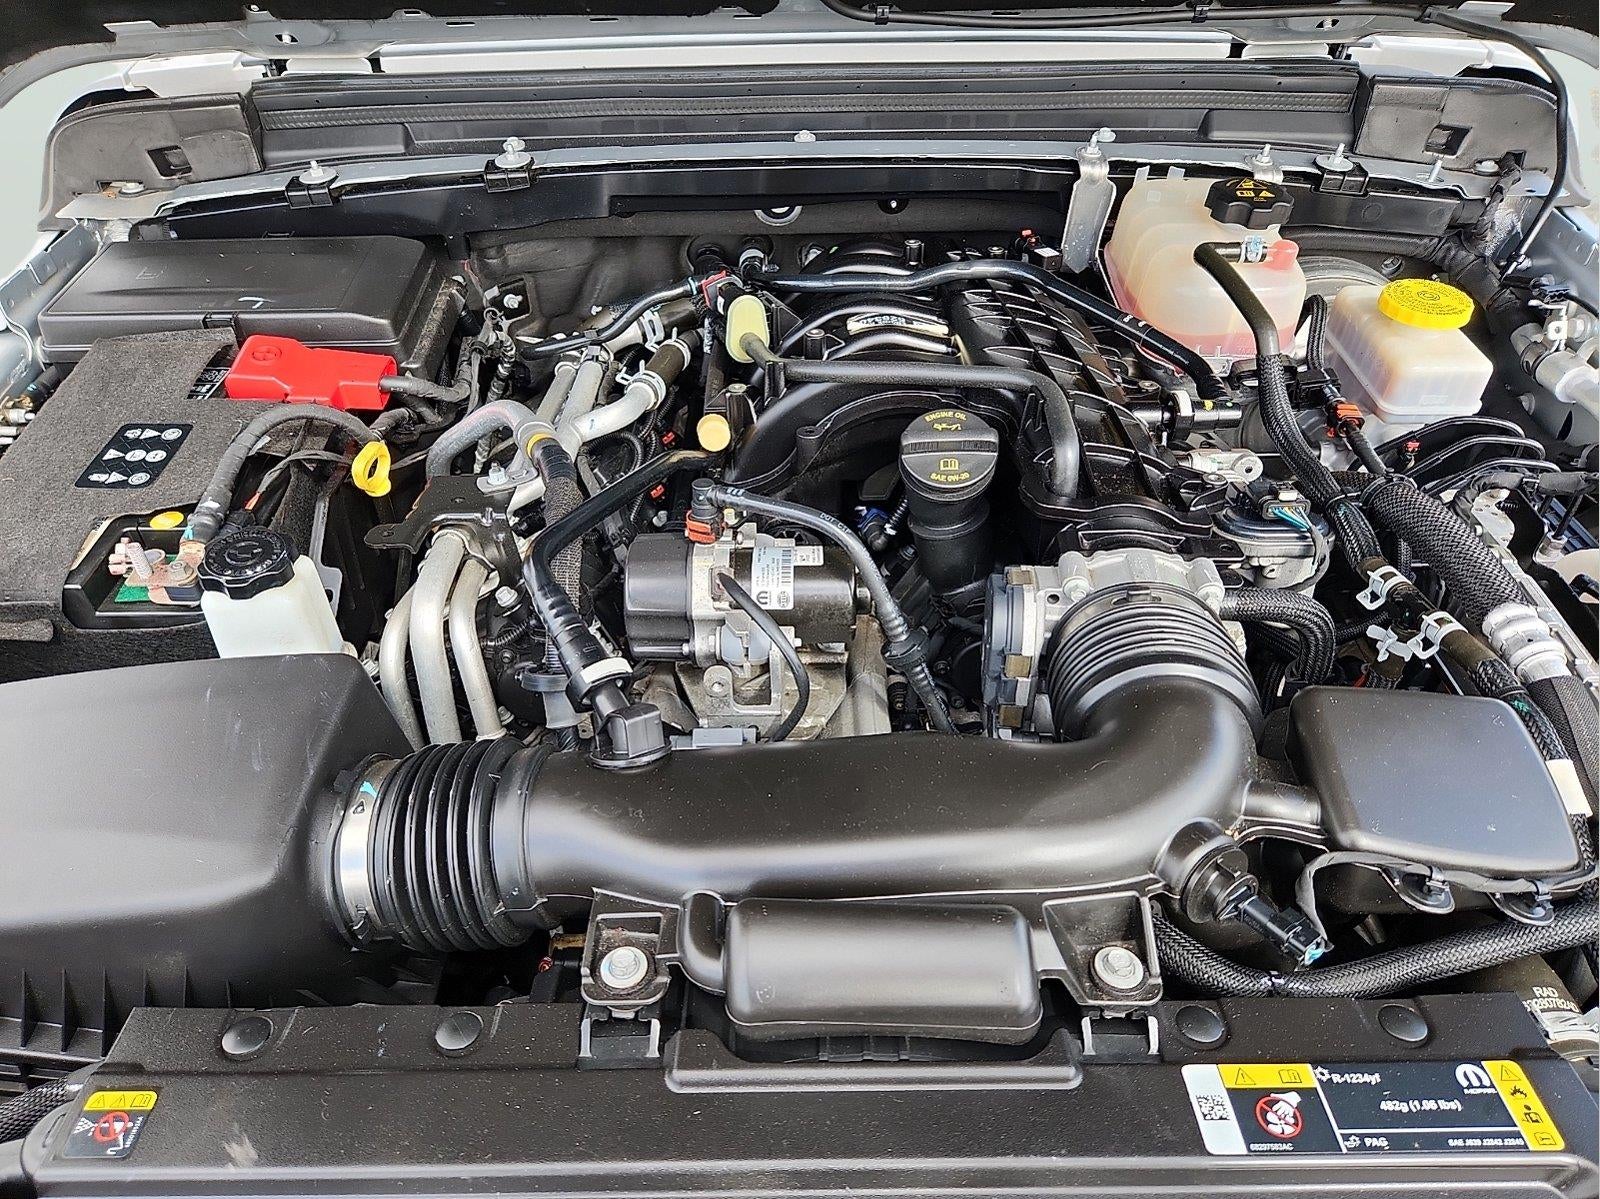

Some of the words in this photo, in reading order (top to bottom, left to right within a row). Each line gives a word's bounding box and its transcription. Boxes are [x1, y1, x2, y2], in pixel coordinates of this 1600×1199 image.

[924, 411, 954, 422] ENGINE
[955, 411, 967, 420] OIL
[930, 472, 947, 482] SAE
[1532, 986, 1558, 998] RAD
[1330, 1072, 1381, 1085] R-1234yf
[1380, 1100, 1409, 1113] 482g
[1364, 1136, 1388, 1147] PAG
